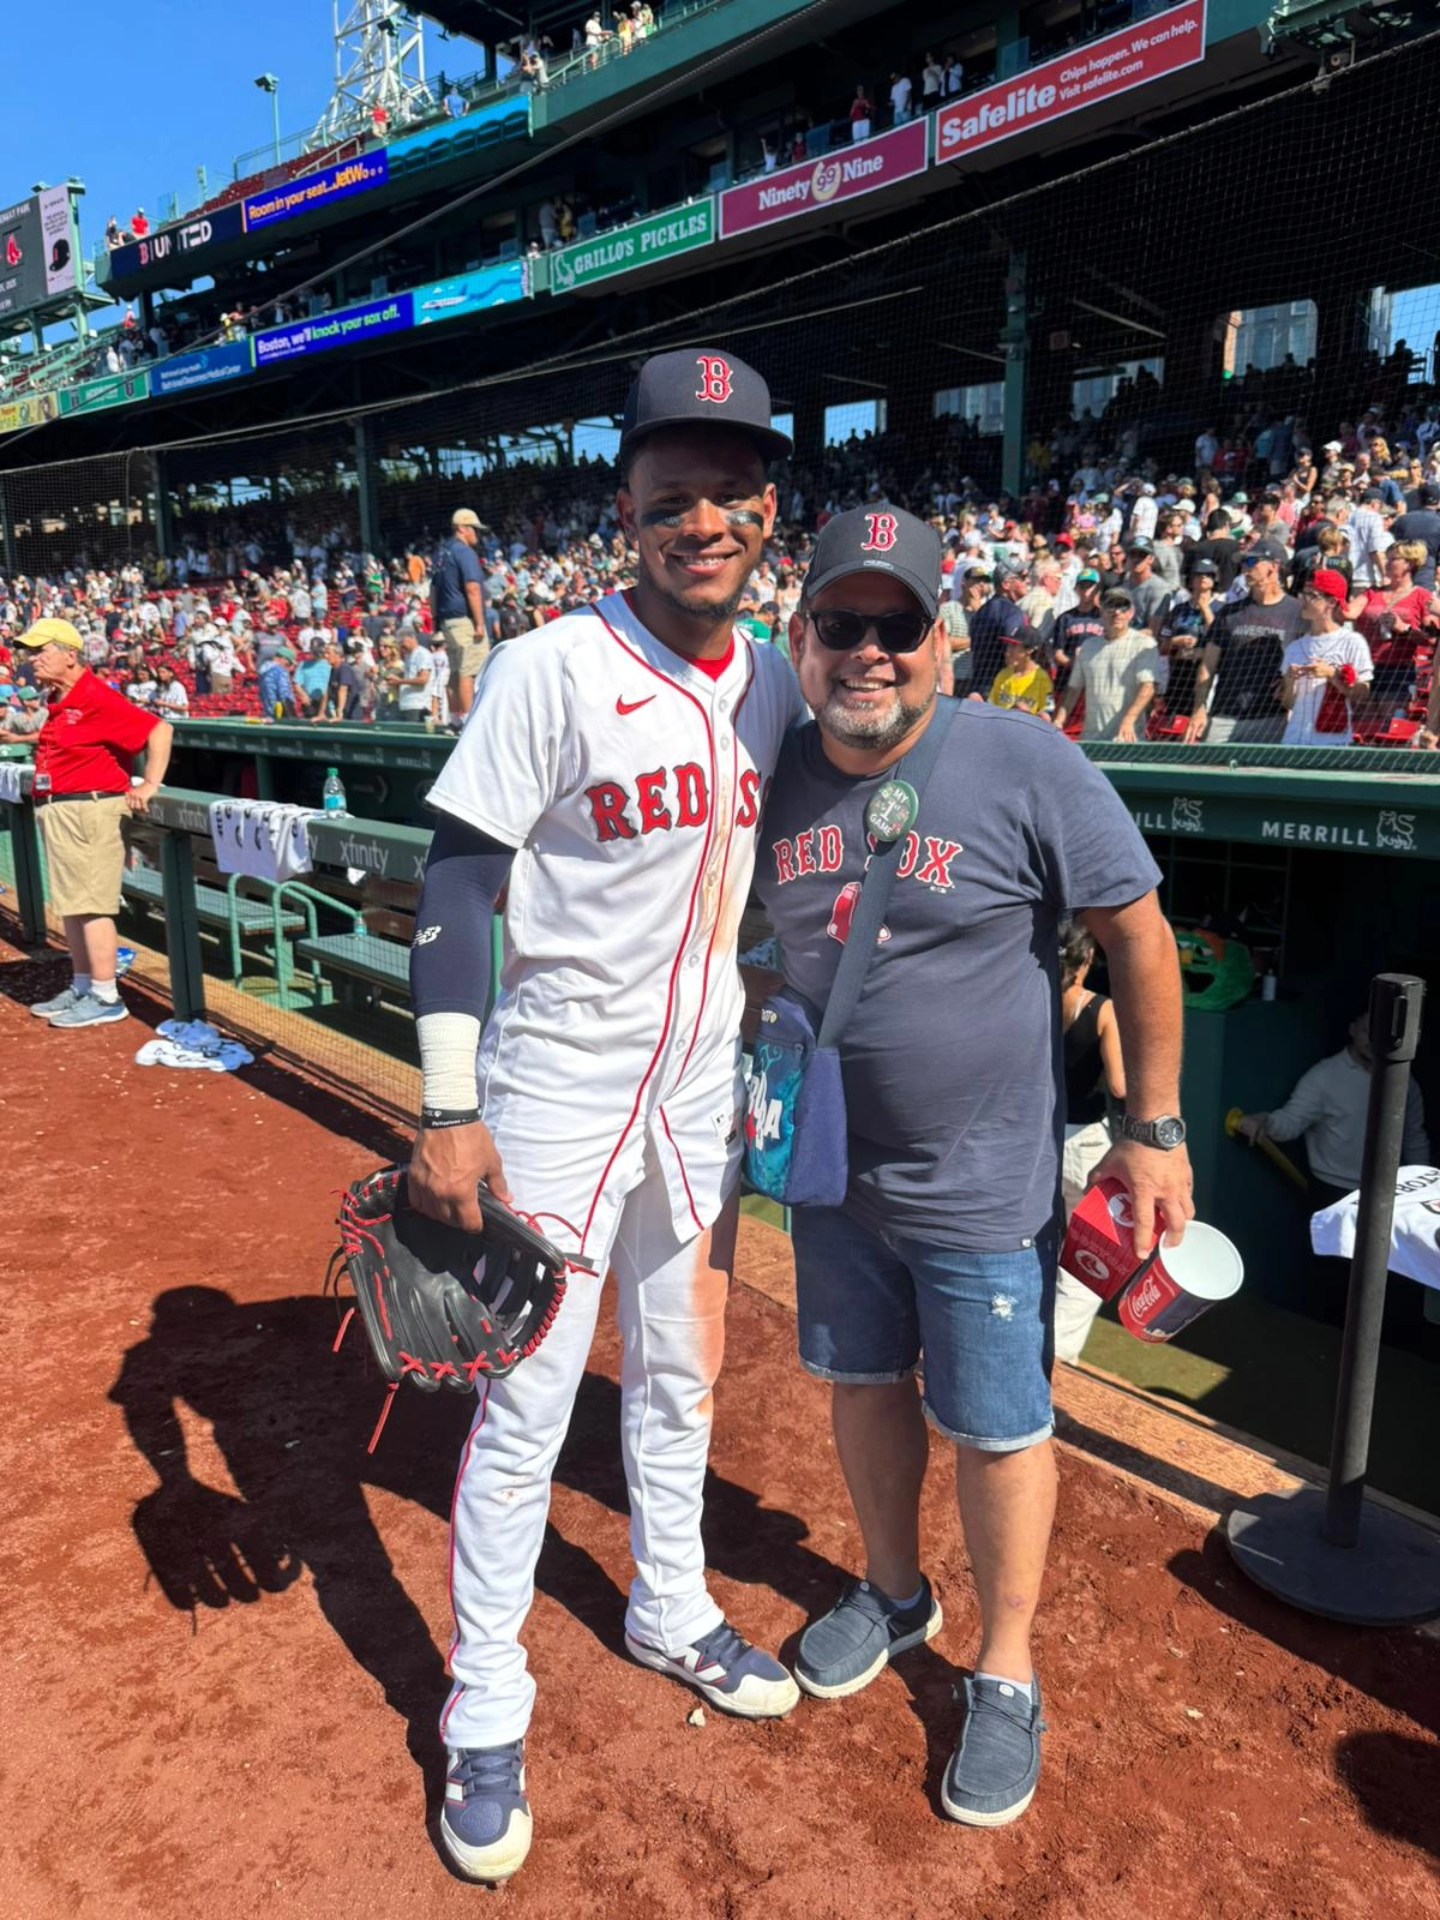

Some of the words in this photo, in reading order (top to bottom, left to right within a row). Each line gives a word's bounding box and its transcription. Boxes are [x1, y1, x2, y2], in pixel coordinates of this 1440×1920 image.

[1060, 65, 1087, 84] Chips
[1089, 48, 1130, 72] happen.
[1131, 37, 1148, 53] We
[1150, 31, 1170, 46] can
[1171, 20, 1198, 38] help.
[1059, 85, 1082, 101] Visit
[1082, 60, 1144, 92] safelite.com
[942, 80, 1056, 148] Safelite
[249, 201, 275, 219] Room
[275, 197, 285, 210] in
[285, 191, 305, 210] your
[758, 181, 811, 212] Ninety
[842, 153, 884, 182] Nine
[574, 240, 634, 276] GRILLO'S
[641, 212, 707, 252] PICKLES
[257, 336, 291, 355] Boston,
[312, 320, 341, 339] knock
[341, 316, 362, 335] your
[382, 303, 400, 321] off.
[696, 355, 733, 403] B
[861, 512, 898, 552] B
[585, 762, 710, 842] RED
[870, 813, 893, 837] GAME
[340, 834, 388, 875] xfinity
[772, 824, 844, 885] RED
[1261, 821, 1369, 847] MERRILL
